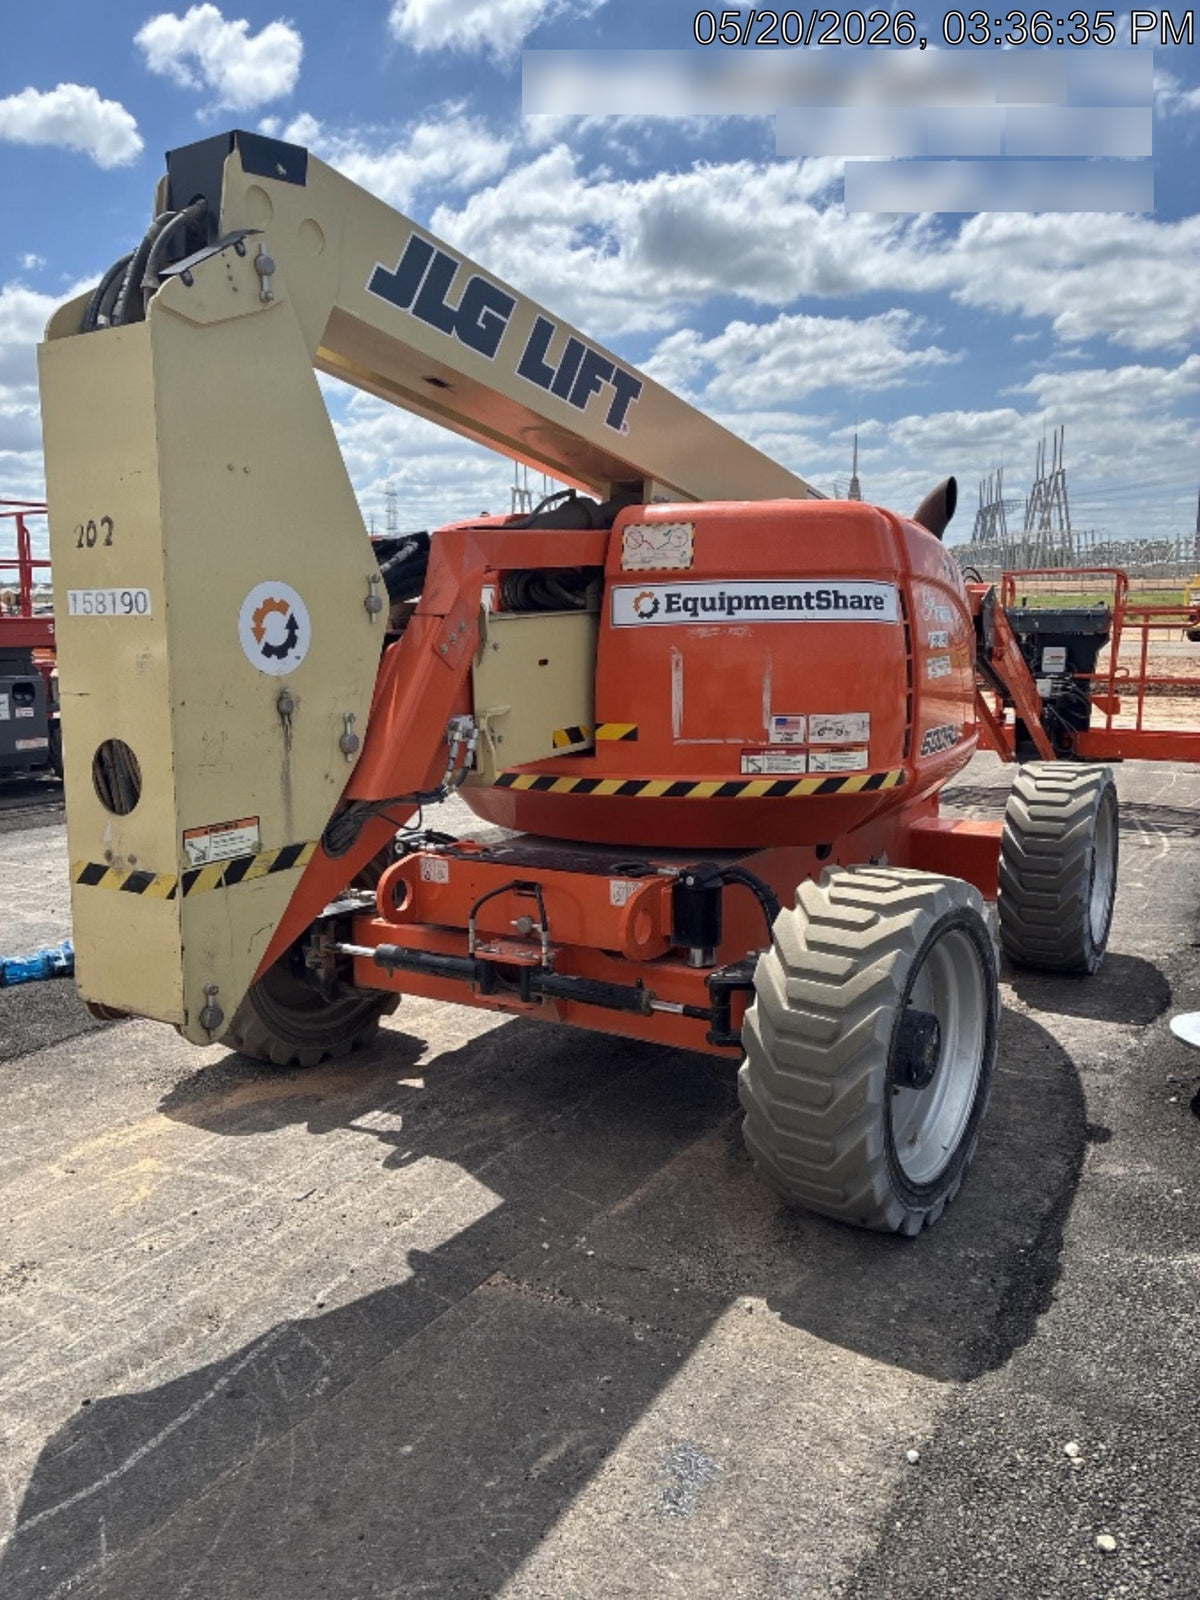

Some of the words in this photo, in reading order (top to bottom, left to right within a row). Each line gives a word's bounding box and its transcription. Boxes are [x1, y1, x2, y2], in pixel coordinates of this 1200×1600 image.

[365, 231, 518, 362] JLG
[514, 313, 643, 436] LIFT
[69, 591, 148, 614] 158190
[664, 590, 885, 616] EquipmentShare
